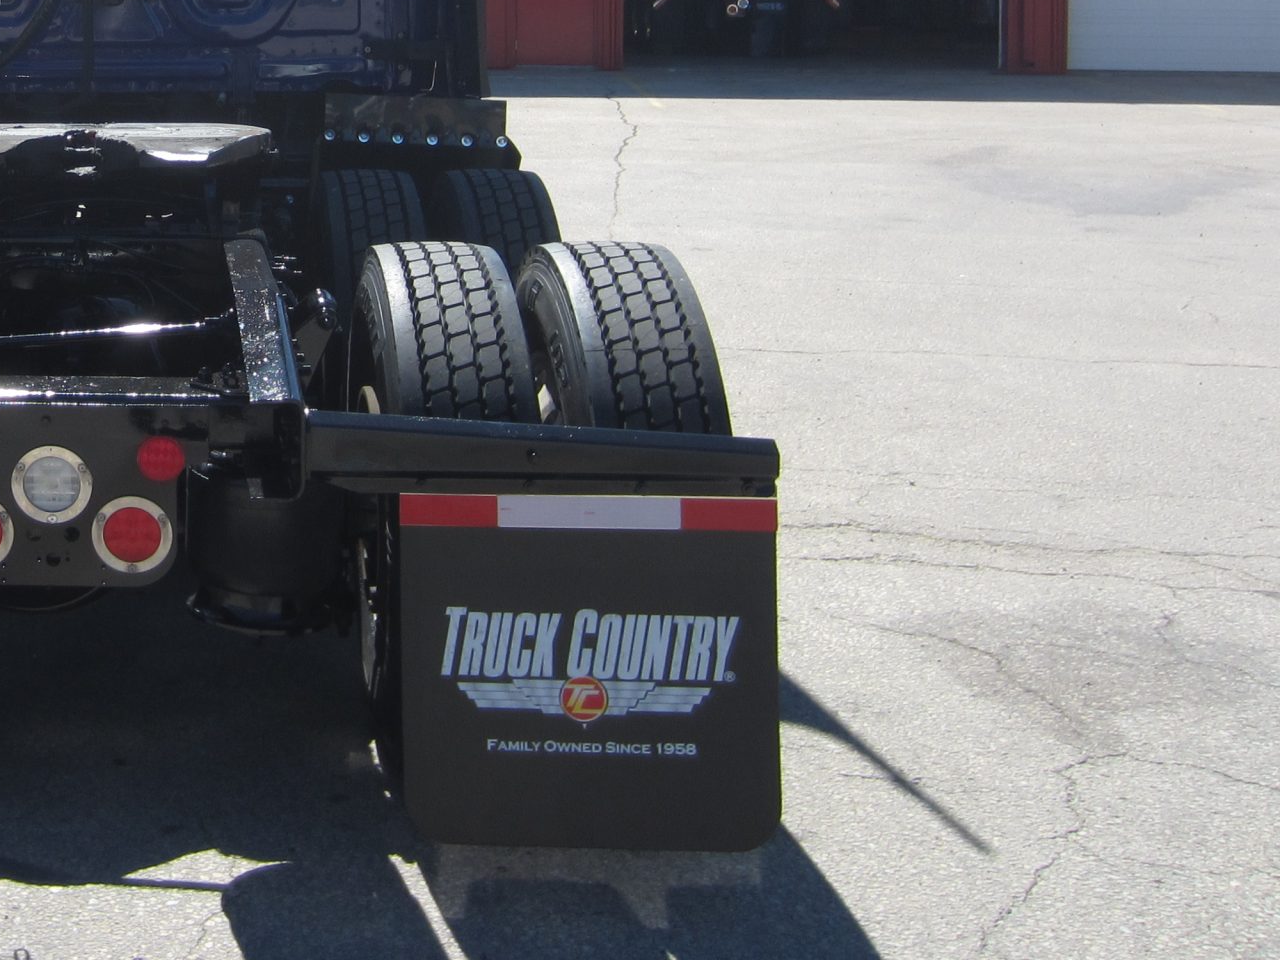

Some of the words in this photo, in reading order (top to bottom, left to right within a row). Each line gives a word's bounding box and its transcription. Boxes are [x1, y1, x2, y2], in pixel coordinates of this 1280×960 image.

[440, 606, 562, 678] TRUCK
[486, 738, 541, 752] FAMILY
[543, 740, 603, 754] OWNED
[605, 741, 653, 755] SINCE
[656, 743, 697, 756] 1958
